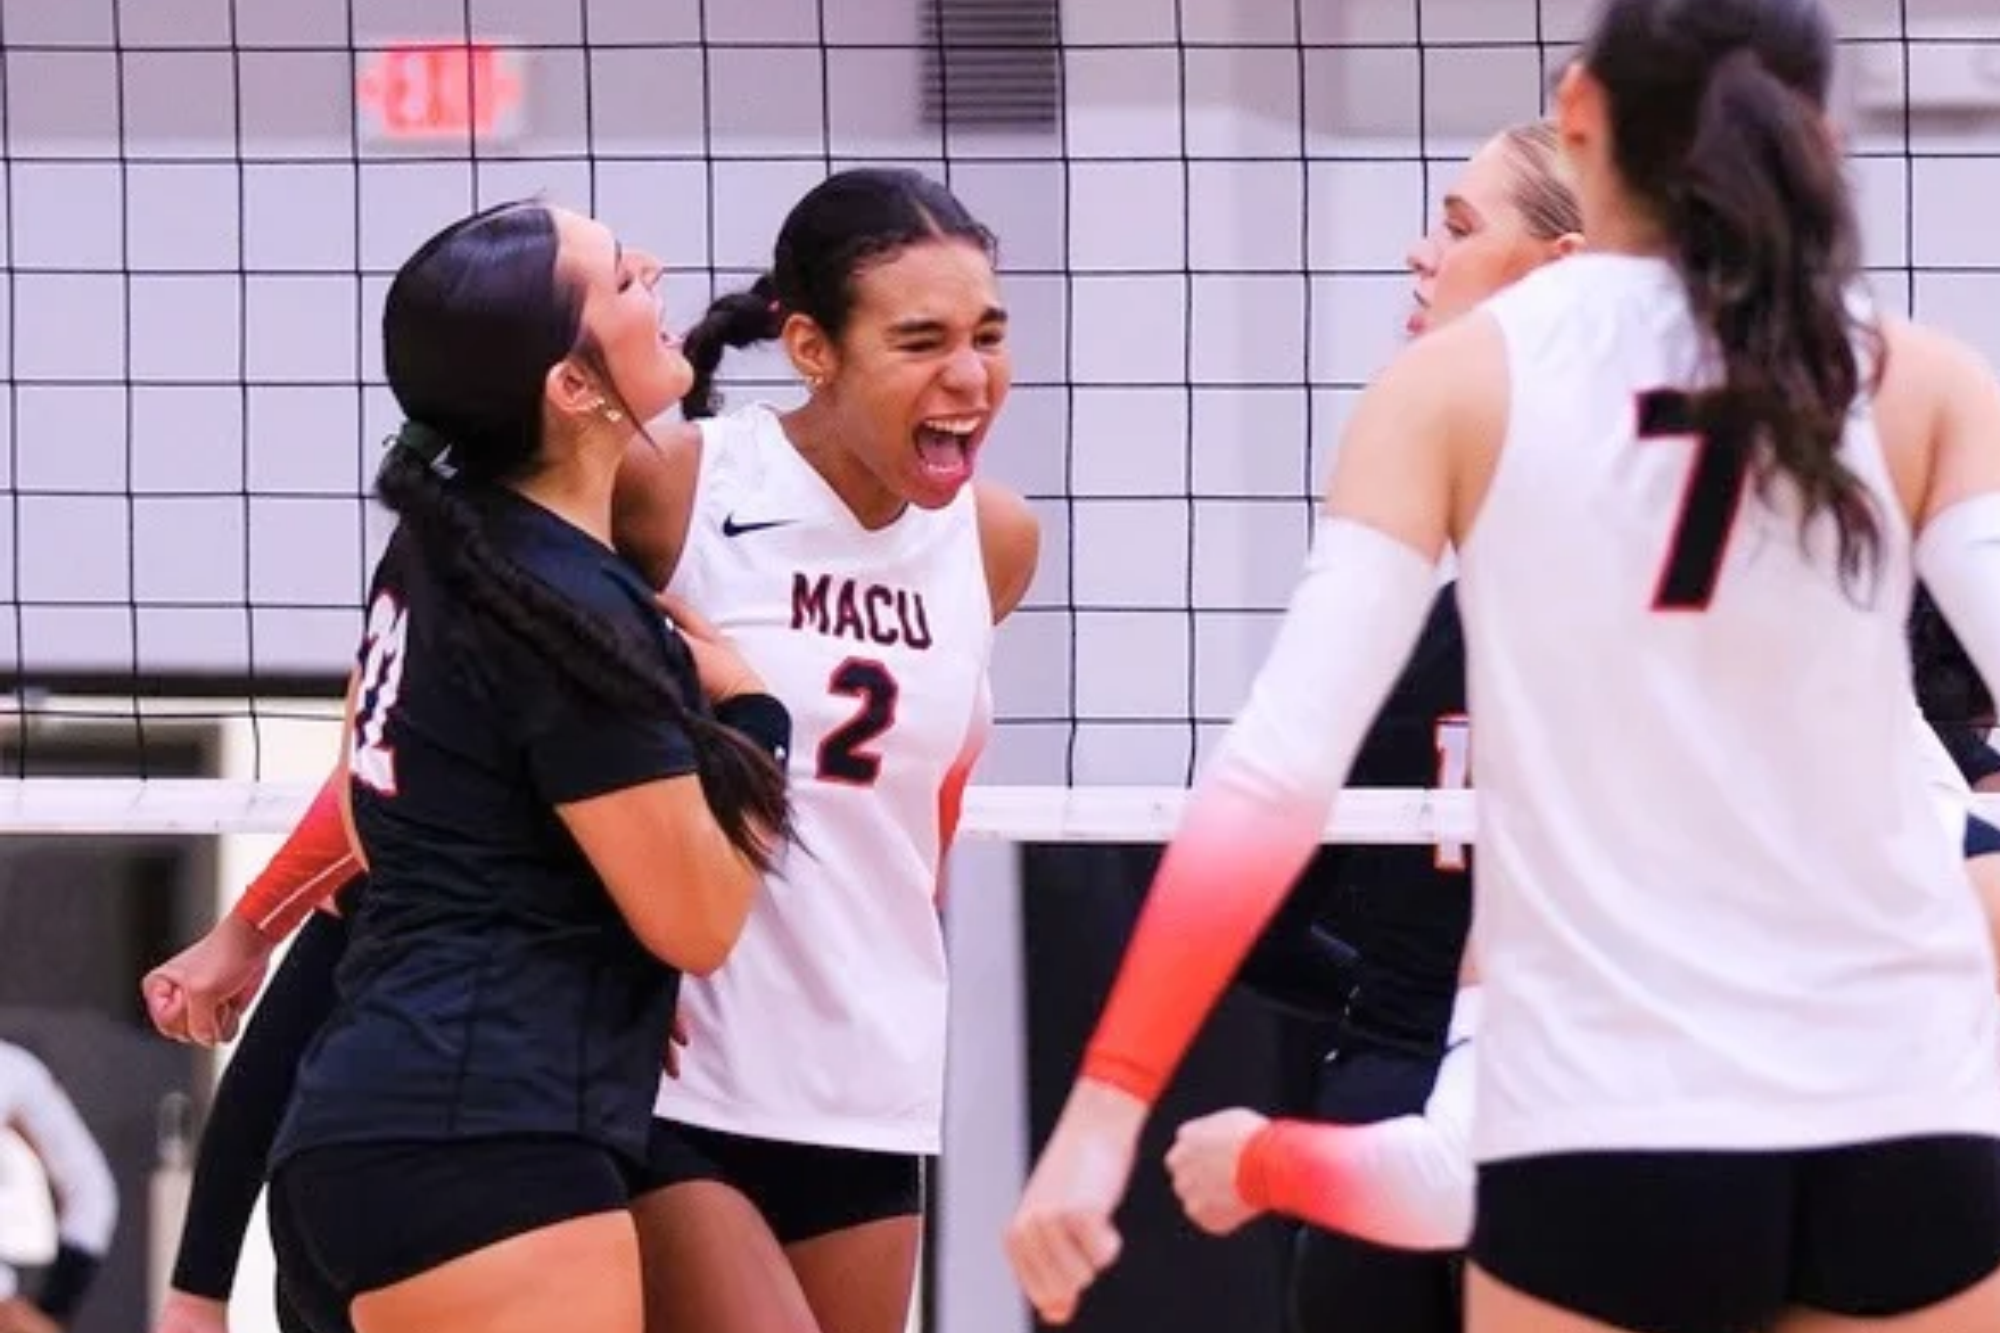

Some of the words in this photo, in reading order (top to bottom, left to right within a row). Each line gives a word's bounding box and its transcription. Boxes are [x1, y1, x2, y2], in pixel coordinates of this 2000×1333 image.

[1634, 388, 1762, 611] 7
[790, 572, 933, 650] MACU
[815, 656, 898, 787] 2
